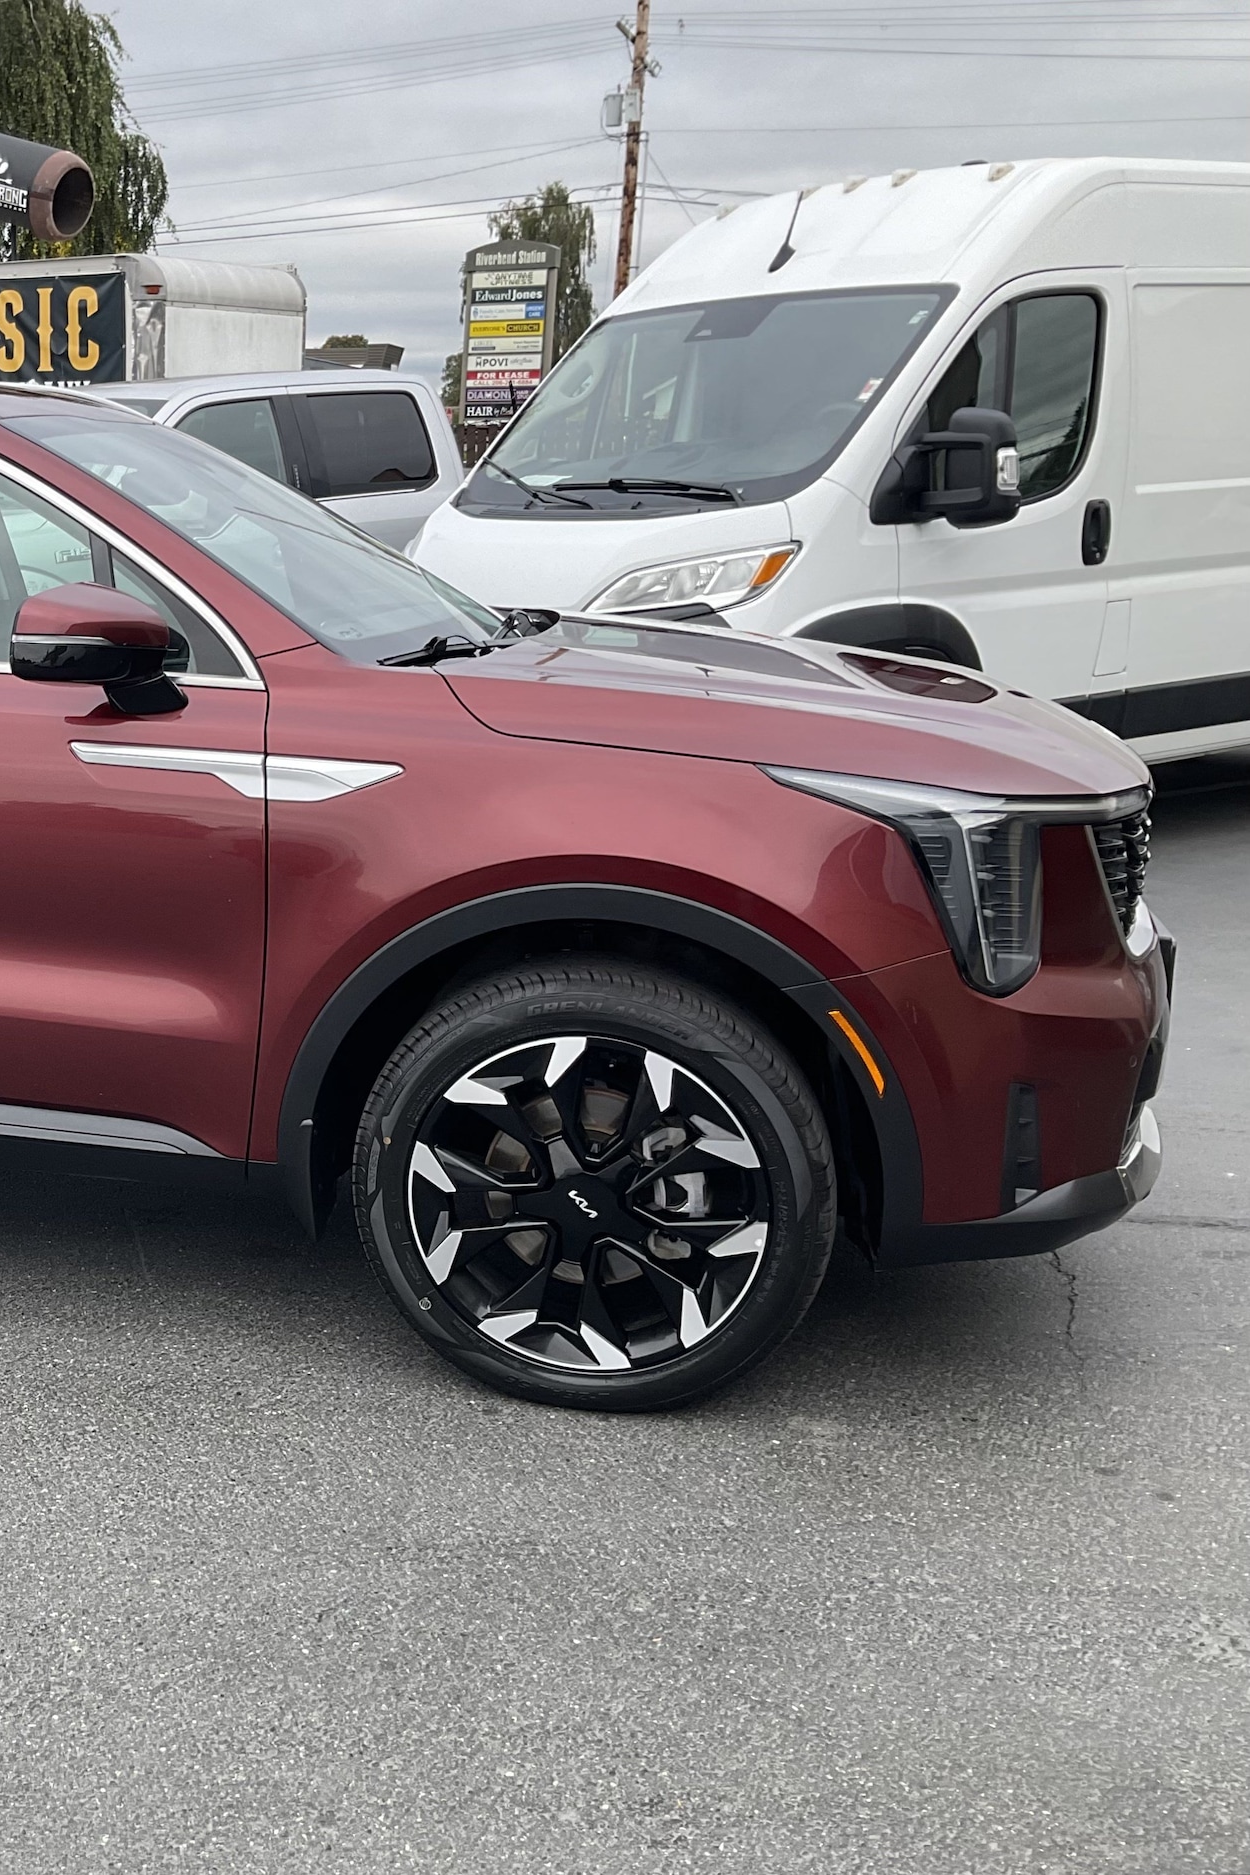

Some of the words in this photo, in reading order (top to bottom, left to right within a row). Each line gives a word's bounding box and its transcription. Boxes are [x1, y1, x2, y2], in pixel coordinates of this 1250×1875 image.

[517, 249, 547, 265] Station
[495, 271, 534, 280] ANYTIME
[475, 289, 511, 302] Edward
[510, 289, 543, 301] Jones
[507, 324, 539, 332] CHURCH
[476, 372, 496, 380] FOR
[498, 371, 530, 380] LEASE
[466, 406, 493, 417] HAIR
